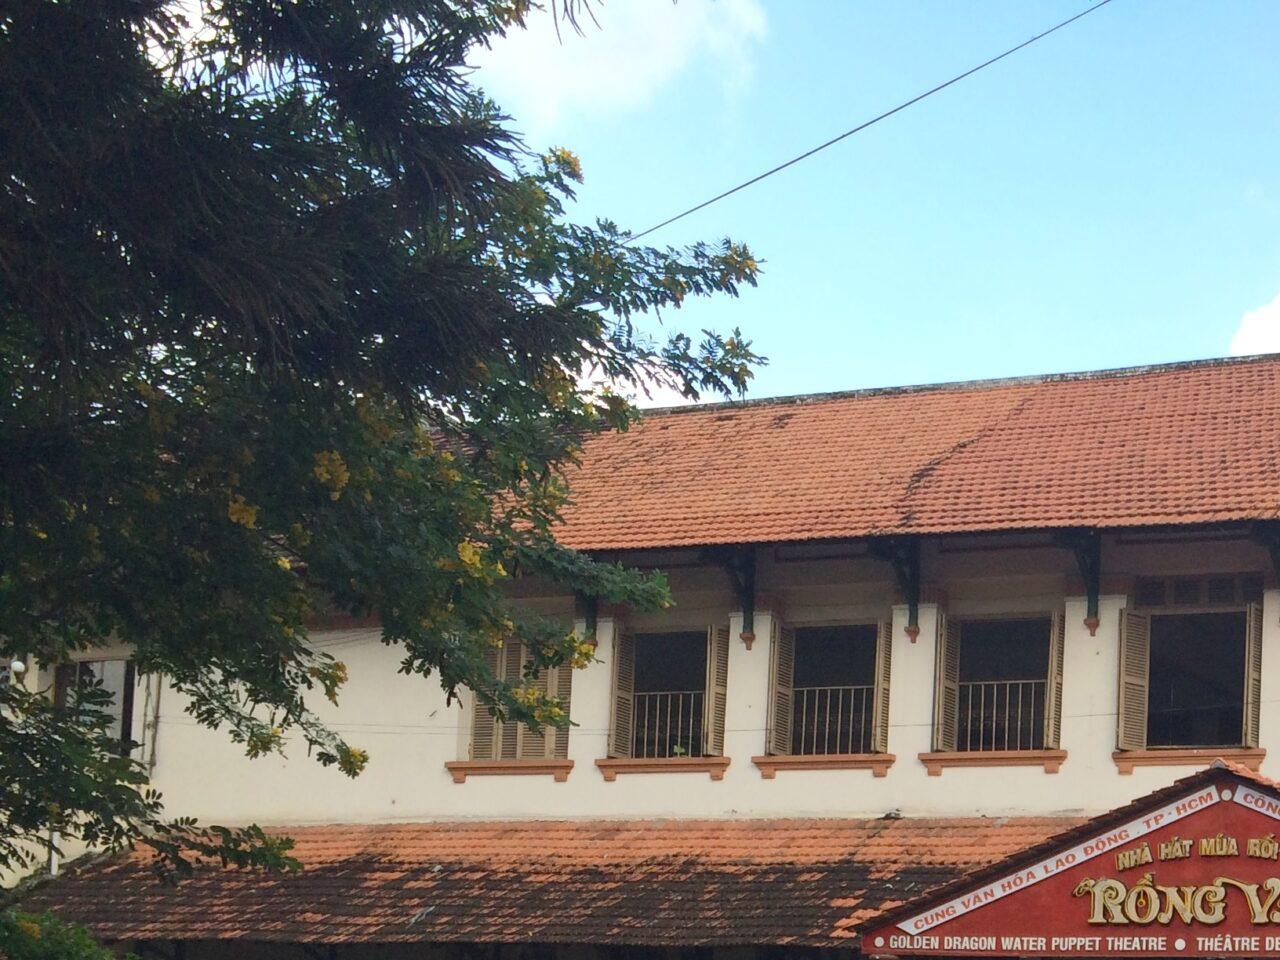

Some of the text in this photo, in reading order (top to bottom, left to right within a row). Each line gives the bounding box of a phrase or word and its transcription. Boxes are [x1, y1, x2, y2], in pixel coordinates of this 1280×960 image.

[1115, 841, 1153, 871] NHÀ
[1158, 835, 1193, 861] HÁT
[1247, 832, 1280, 861] RỐI
[914, 905, 957, 930] CUNG
[1001, 870, 1036, 893] HÓA
[1043, 853, 1077, 875] LAO
[890, 936, 1167, 951] GOLDEN DRAGON WATER PUPPET THEATRE
[1197, 934, 1260, 951] THÉÂTRE
